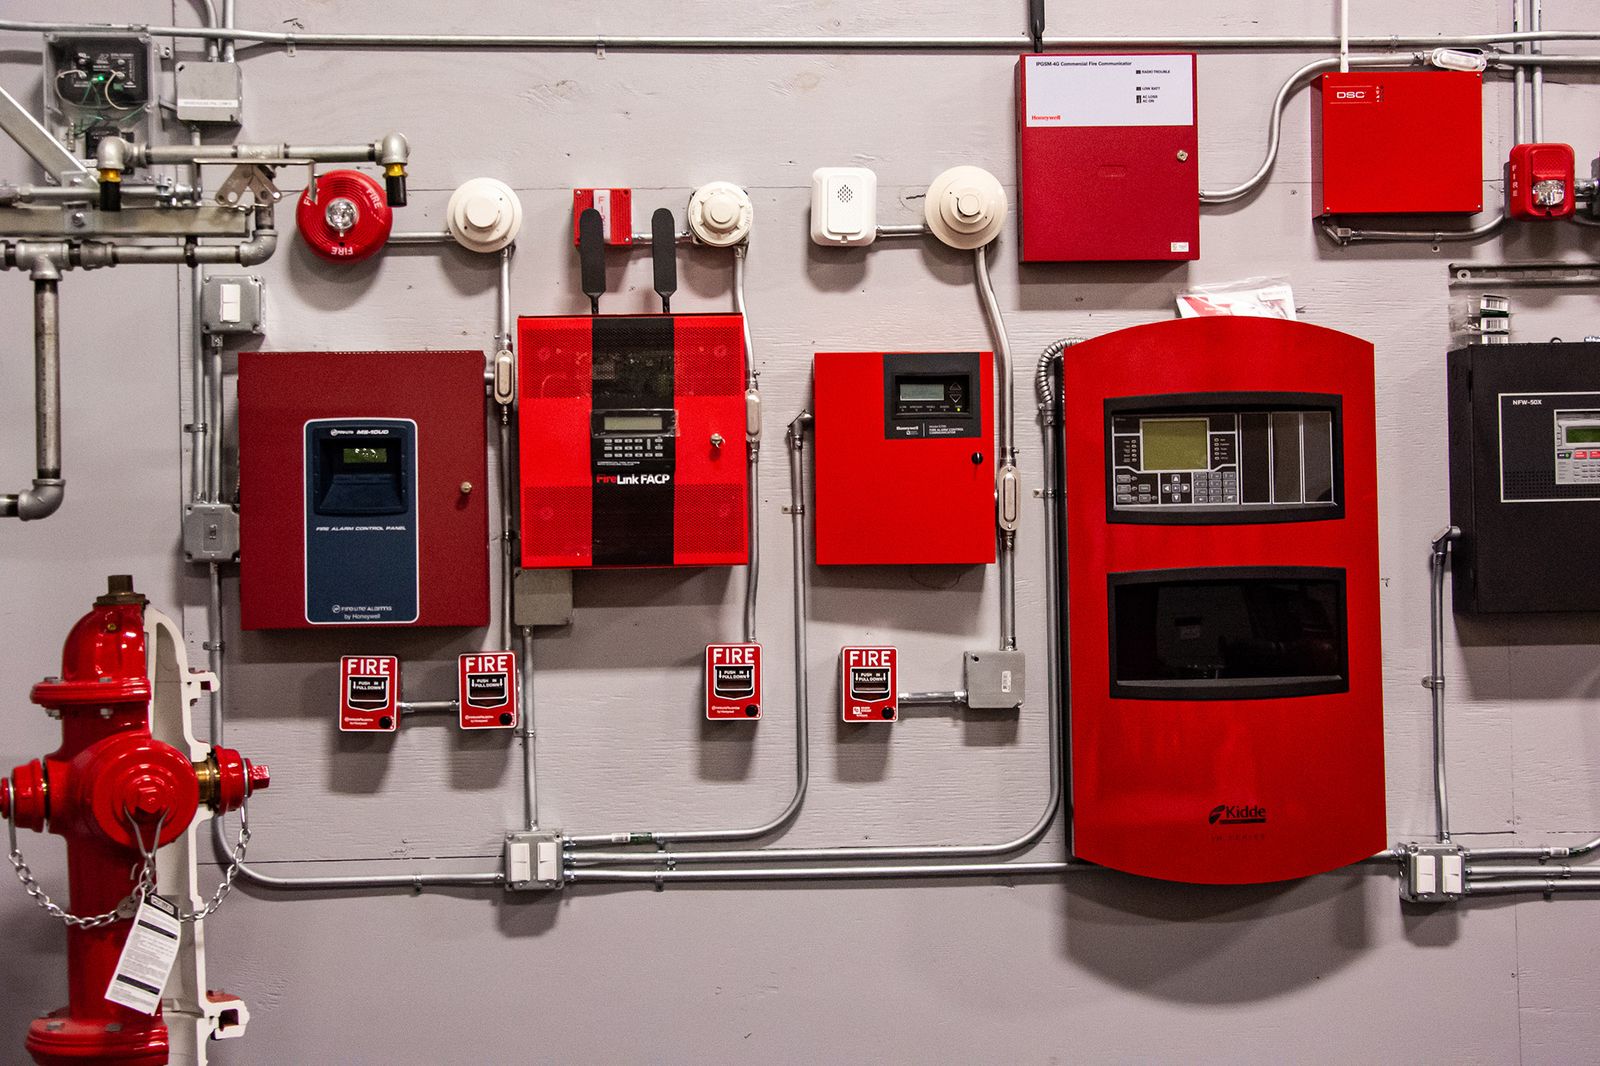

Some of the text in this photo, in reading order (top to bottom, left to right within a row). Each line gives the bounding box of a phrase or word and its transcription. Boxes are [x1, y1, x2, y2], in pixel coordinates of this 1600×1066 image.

[1336, 91, 1365, 99] DSC
[1511, 164, 1519, 197] FIRE
[366, 187, 383, 210] FIRE
[331, 246, 354, 256] FIRE
[640, 473, 671, 484] FACP
[465, 655, 508, 672] FIRE
[713, 648, 755, 664] FIRE
[849, 650, 891, 666] FIRE
[347, 658, 390, 675] FIRE
[1225, 804, 1267, 818] Kidde
